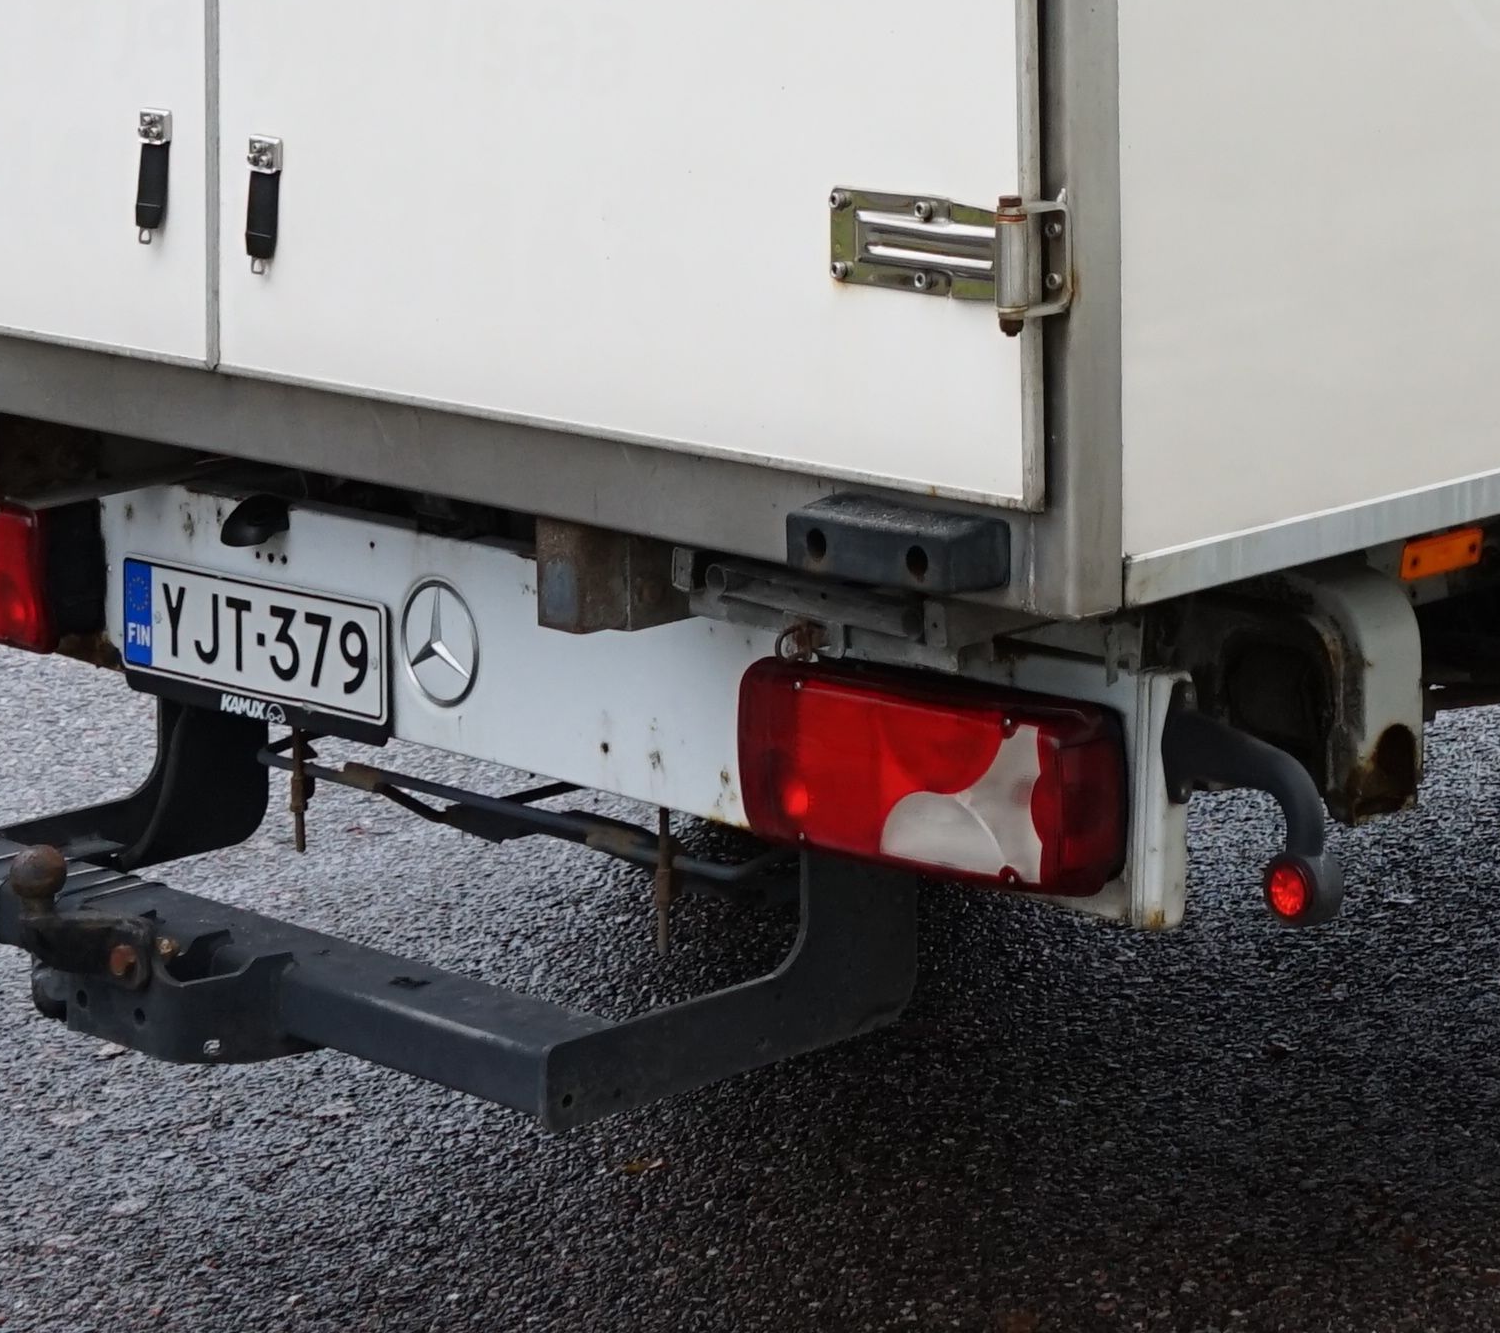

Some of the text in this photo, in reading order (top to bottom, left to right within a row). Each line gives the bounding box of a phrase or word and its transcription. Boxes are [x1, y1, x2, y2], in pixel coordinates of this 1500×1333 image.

[128, 622, 151, 647] FIN
[161, 582, 370, 695] YJT-379
[220, 693, 266, 721] KAMUX
